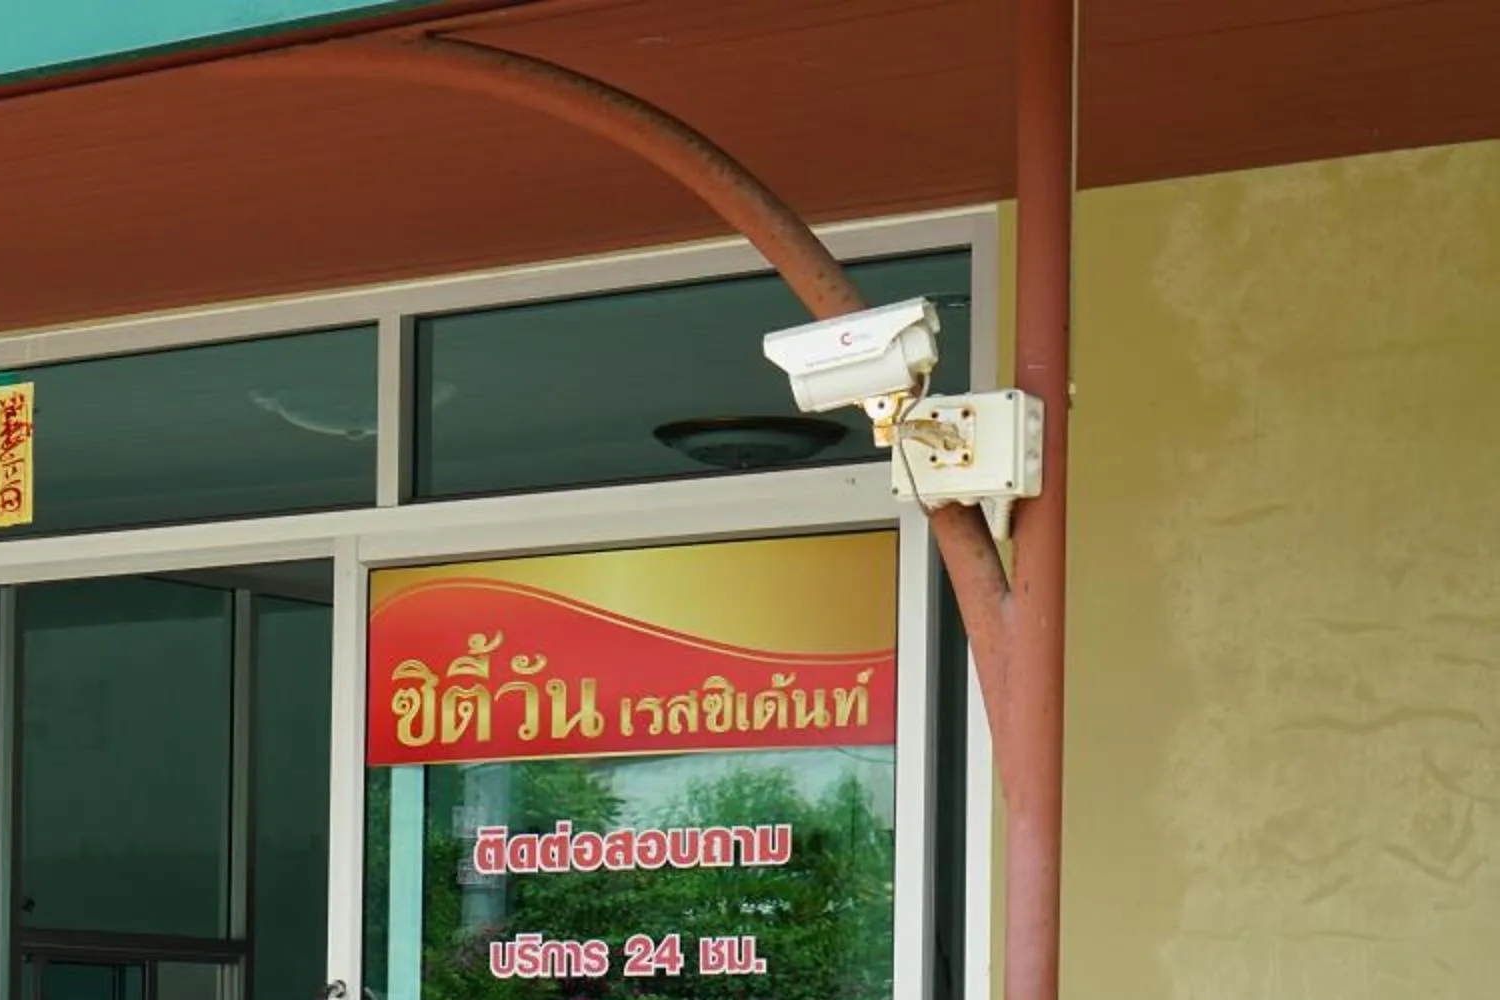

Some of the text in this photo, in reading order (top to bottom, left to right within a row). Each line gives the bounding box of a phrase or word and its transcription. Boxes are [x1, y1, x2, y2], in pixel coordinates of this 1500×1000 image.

[391, 629, 874, 747] ซิตี้วัน เรสซิเด้นท์
[474, 820, 792, 875] ติดต่อสอบถาม
[489, 933, 767, 978] บริการ 24 ชม.
